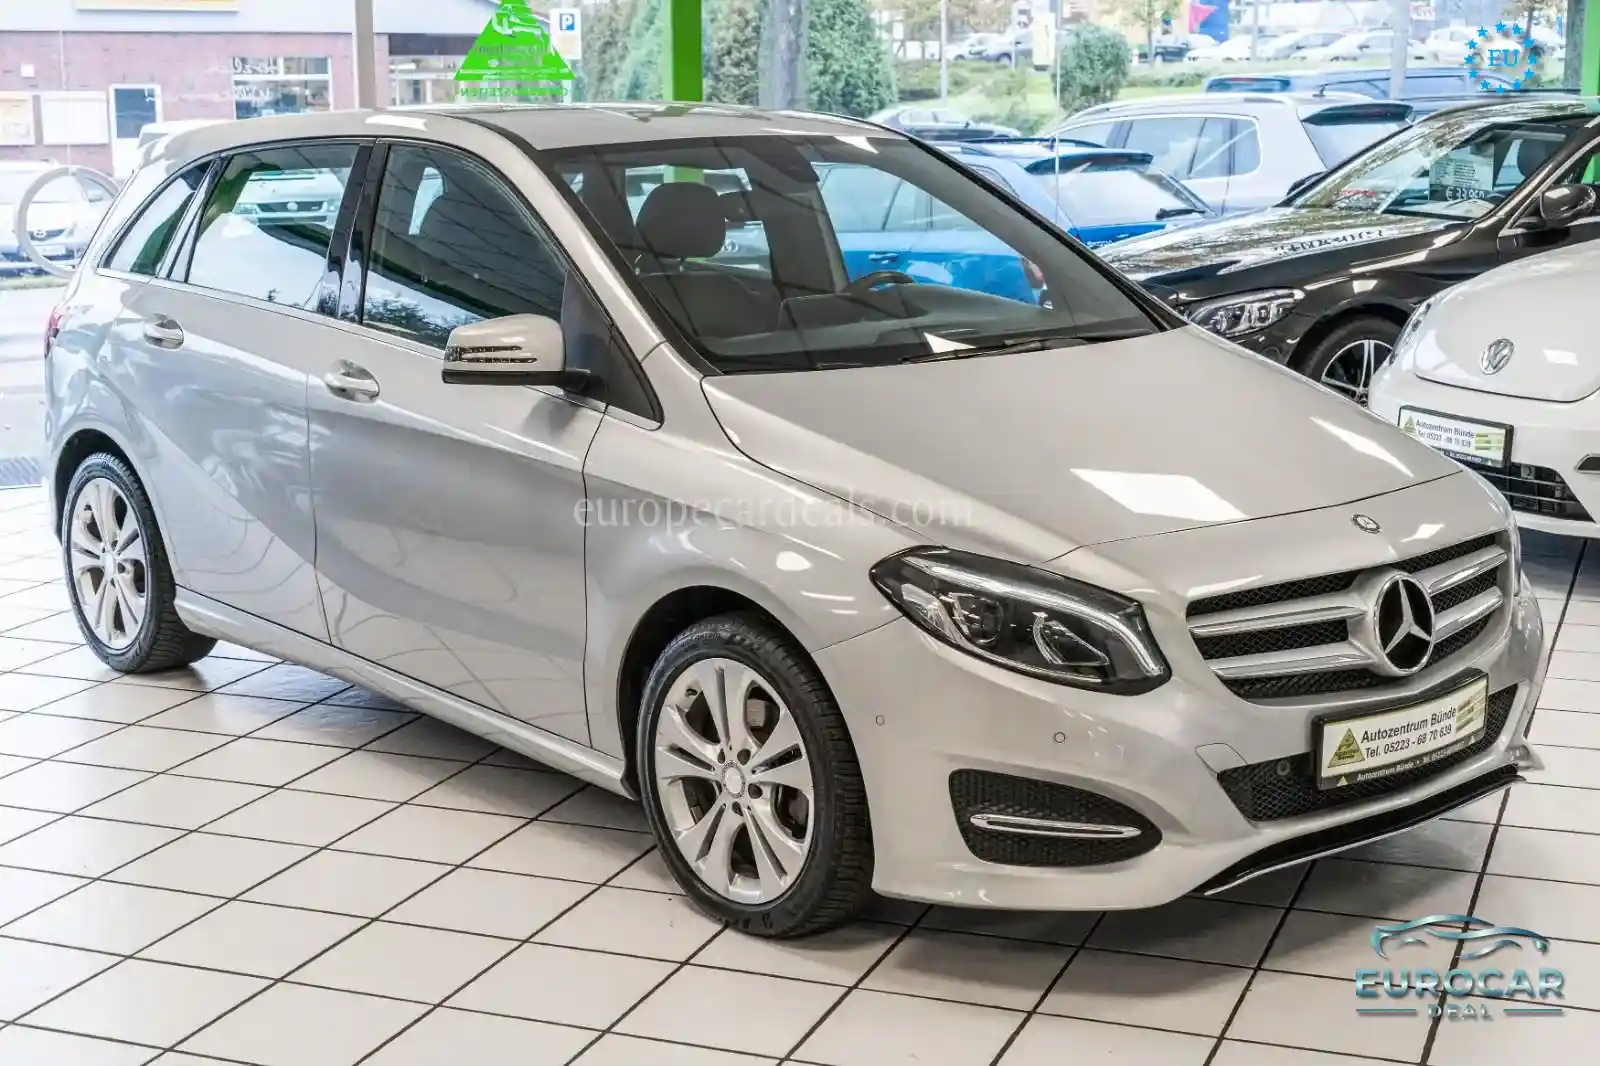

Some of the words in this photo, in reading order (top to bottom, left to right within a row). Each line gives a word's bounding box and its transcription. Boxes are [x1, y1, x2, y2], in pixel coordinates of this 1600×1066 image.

[1361, 718, 1428, 743] Autozentrum
[1430, 706, 1457, 726] Bünde
[1365, 746, 1381, 758] Tel.
[1383, 738, 1410, 754] 05223
